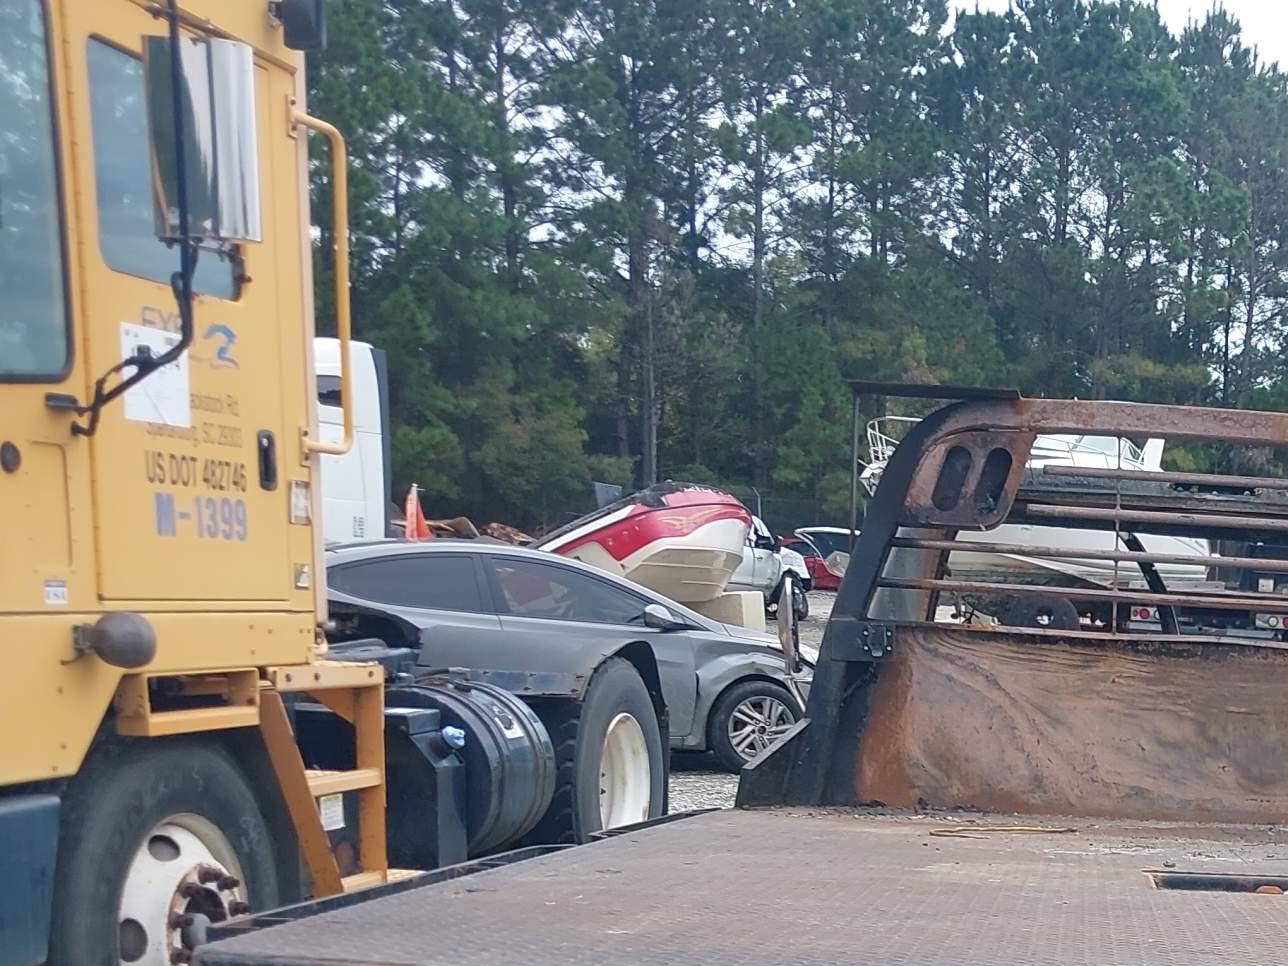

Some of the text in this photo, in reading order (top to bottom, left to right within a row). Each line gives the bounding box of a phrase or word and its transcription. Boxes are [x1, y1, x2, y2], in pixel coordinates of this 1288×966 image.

[144, 449, 248, 493] US DOT 482746
